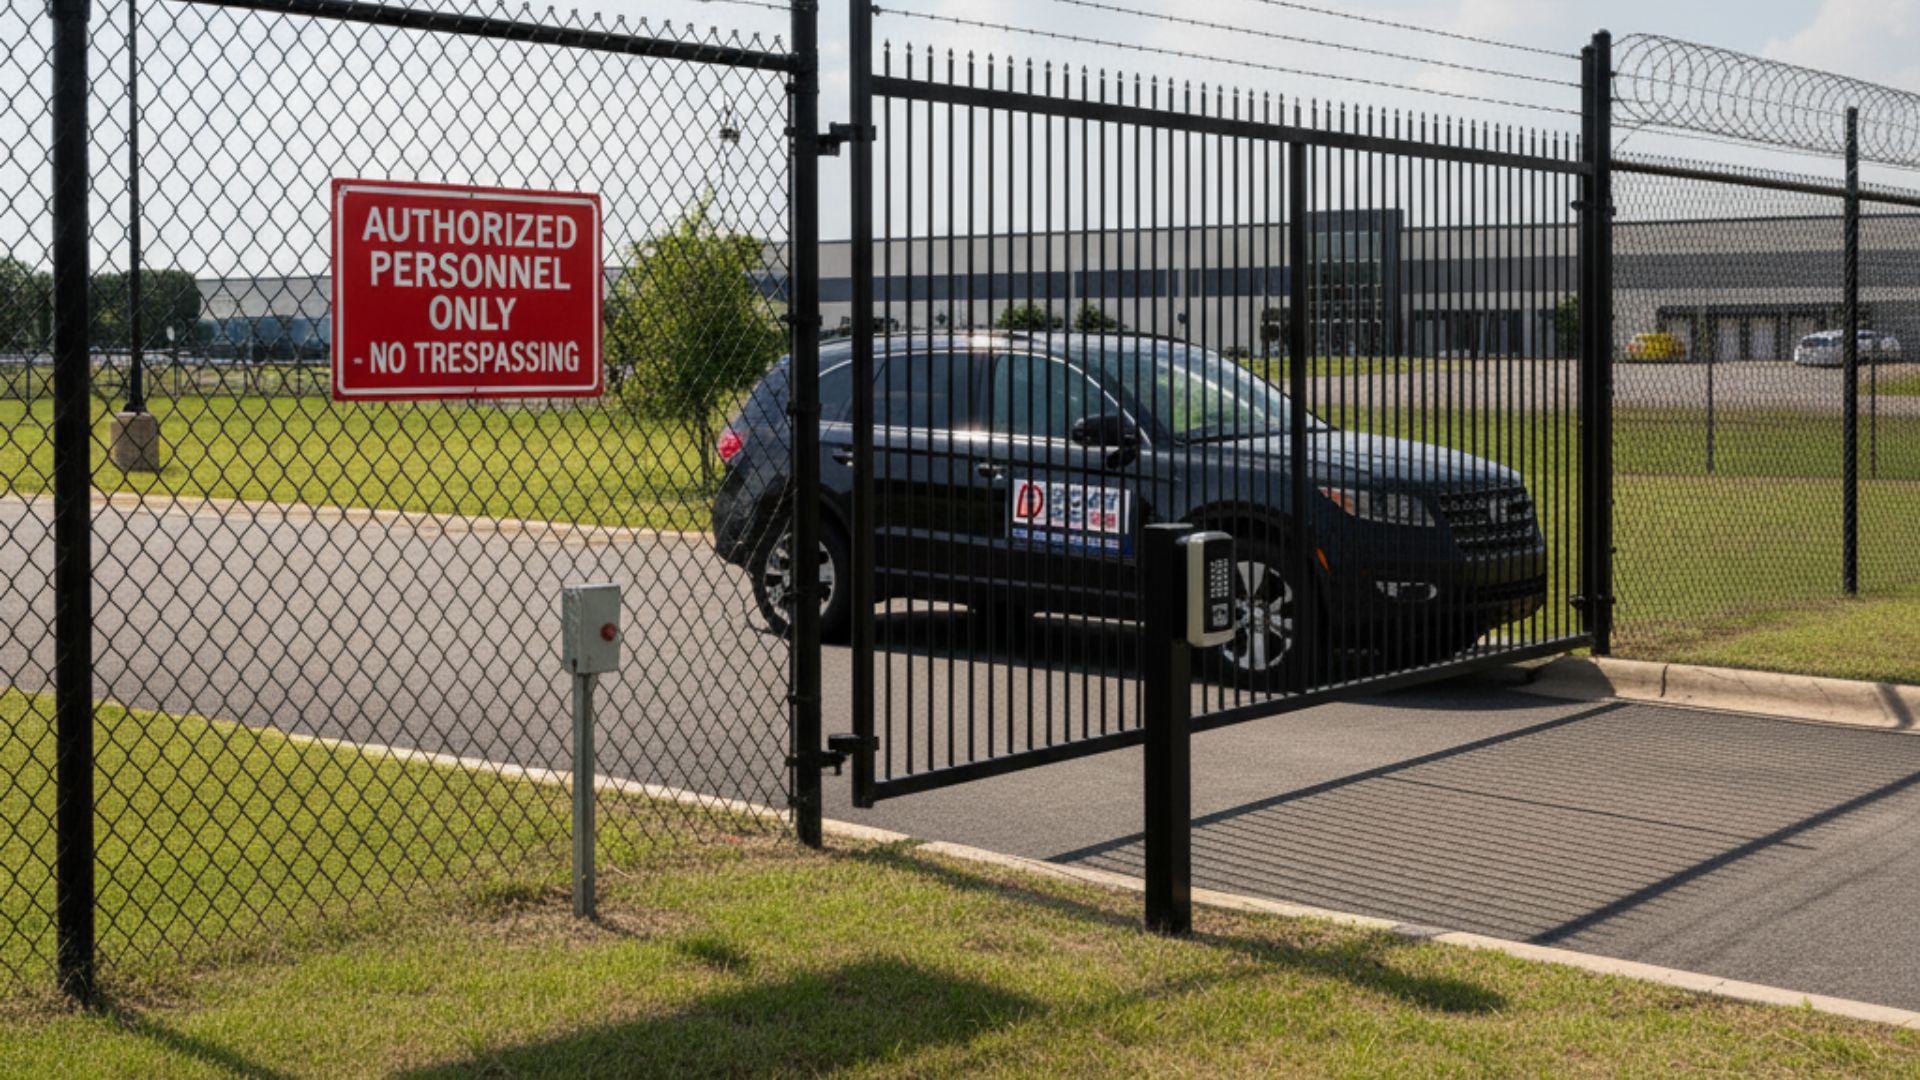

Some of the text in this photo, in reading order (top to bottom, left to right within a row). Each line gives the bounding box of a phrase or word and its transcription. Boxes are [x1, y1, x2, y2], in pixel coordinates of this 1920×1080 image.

[362, 206, 577, 249] AUTHORIZED
[370, 251, 571, 290] PERSONNEL
[429, 295, 516, 331] ONLY
[370, 342, 406, 373] NO
[414, 341, 579, 373] TRESPASSING
